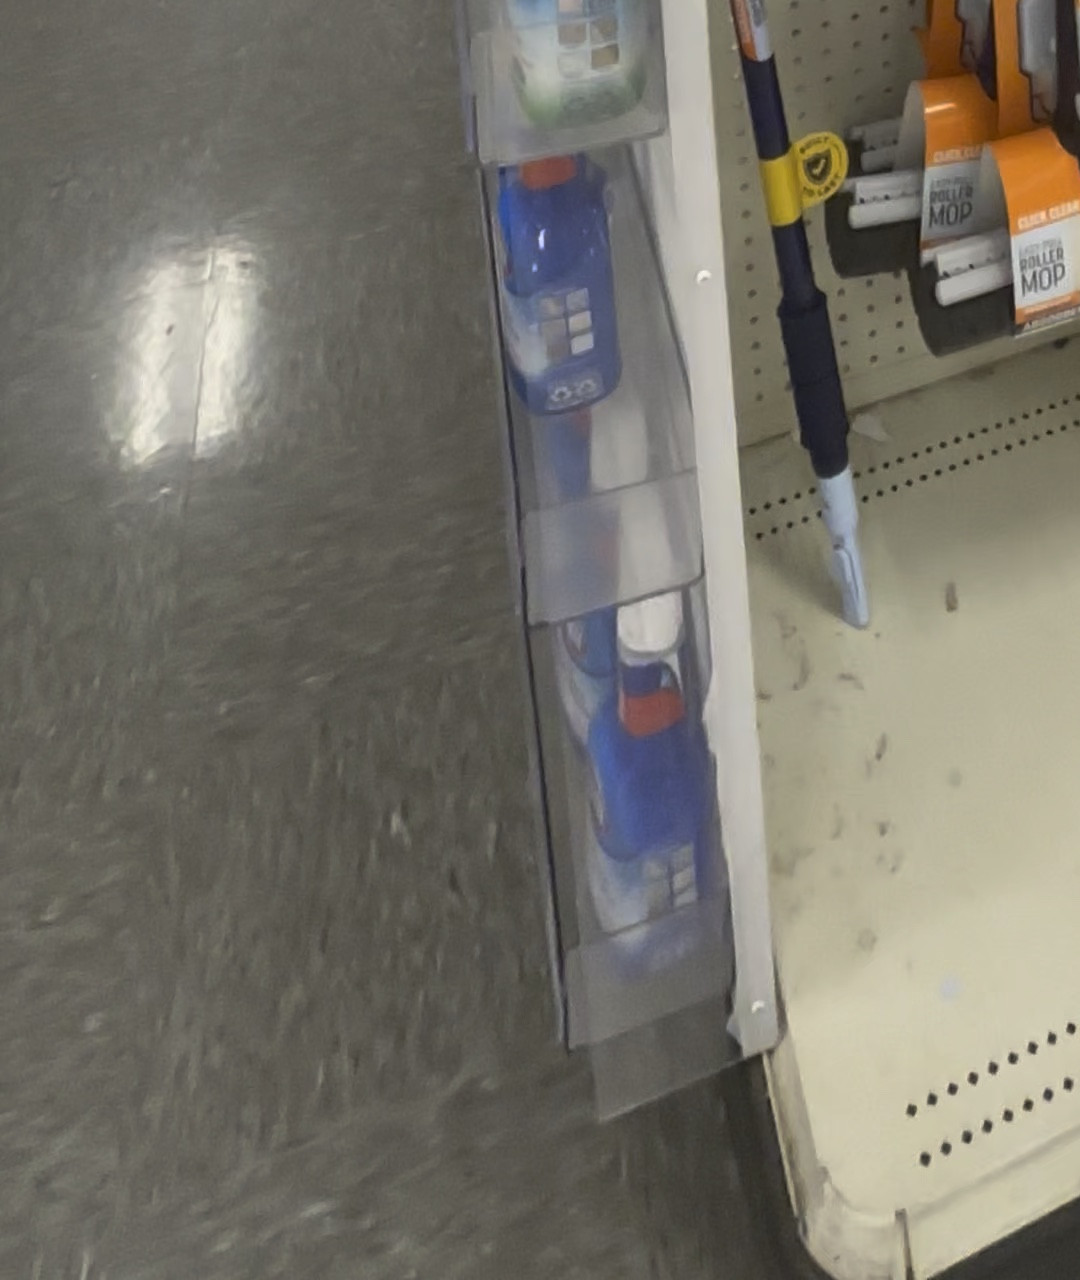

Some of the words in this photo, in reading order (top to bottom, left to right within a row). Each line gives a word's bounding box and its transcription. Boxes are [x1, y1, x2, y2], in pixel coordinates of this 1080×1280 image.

[929, 201, 973, 229] MOP
[1019, 247, 1065, 274] ROLLER
[1021, 263, 1066, 298] MOP
